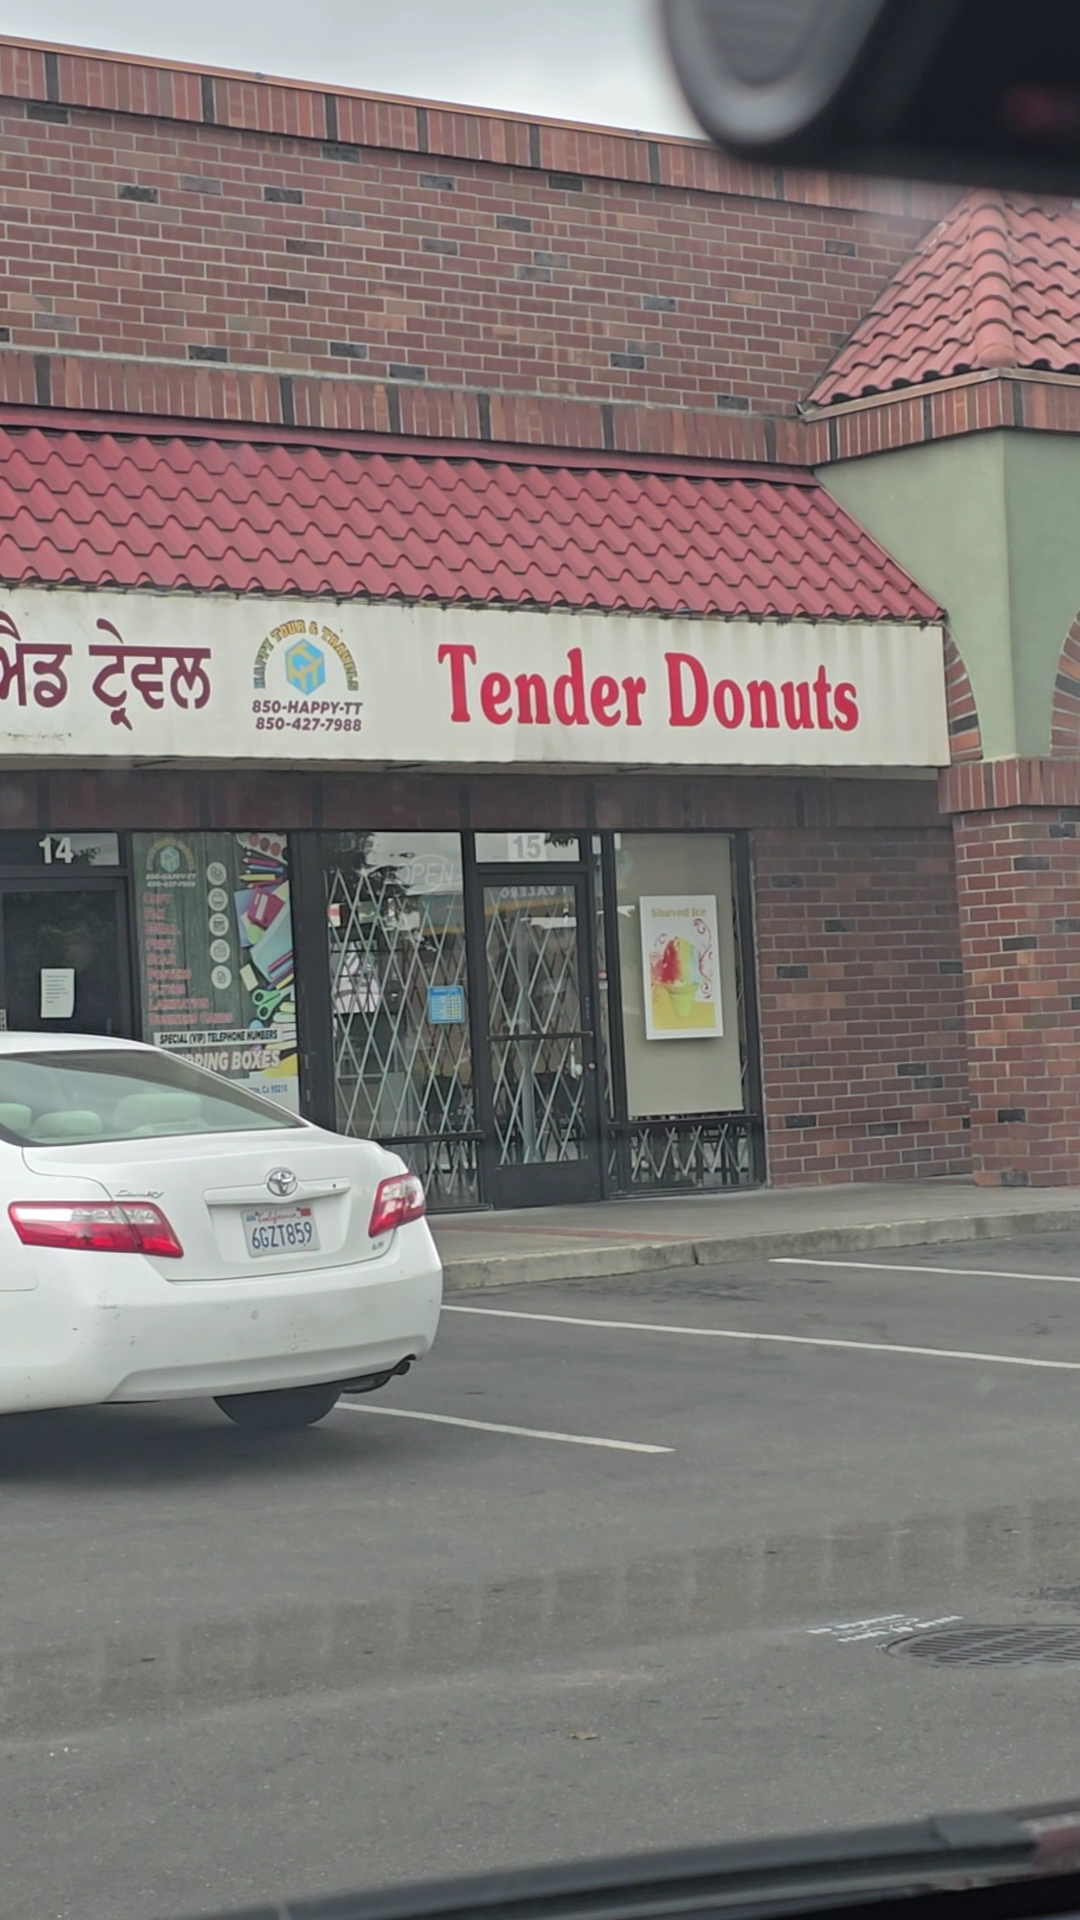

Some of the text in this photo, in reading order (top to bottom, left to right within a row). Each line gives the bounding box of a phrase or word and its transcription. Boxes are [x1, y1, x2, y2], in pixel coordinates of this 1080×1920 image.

[253, 619, 359, 691] HAPPY TOUR & TRAVELS
[437, 643, 860, 732] Tender Donuts
[252, 700, 363, 715] 850-HAPPY-TT
[255, 716, 363, 732] 850-427-7988
[38, 836, 75, 864] 14
[512, 835, 543, 859] 15
[160, 1033, 189, 1045] SPECIAL
[207, 1031, 246, 1043] TELEPHONE
[247, 1030, 278, 1040] NUMBERS
[230, 1049, 281, 1070] BOXES
[252, 1221, 312, 1249] 6GZT859
